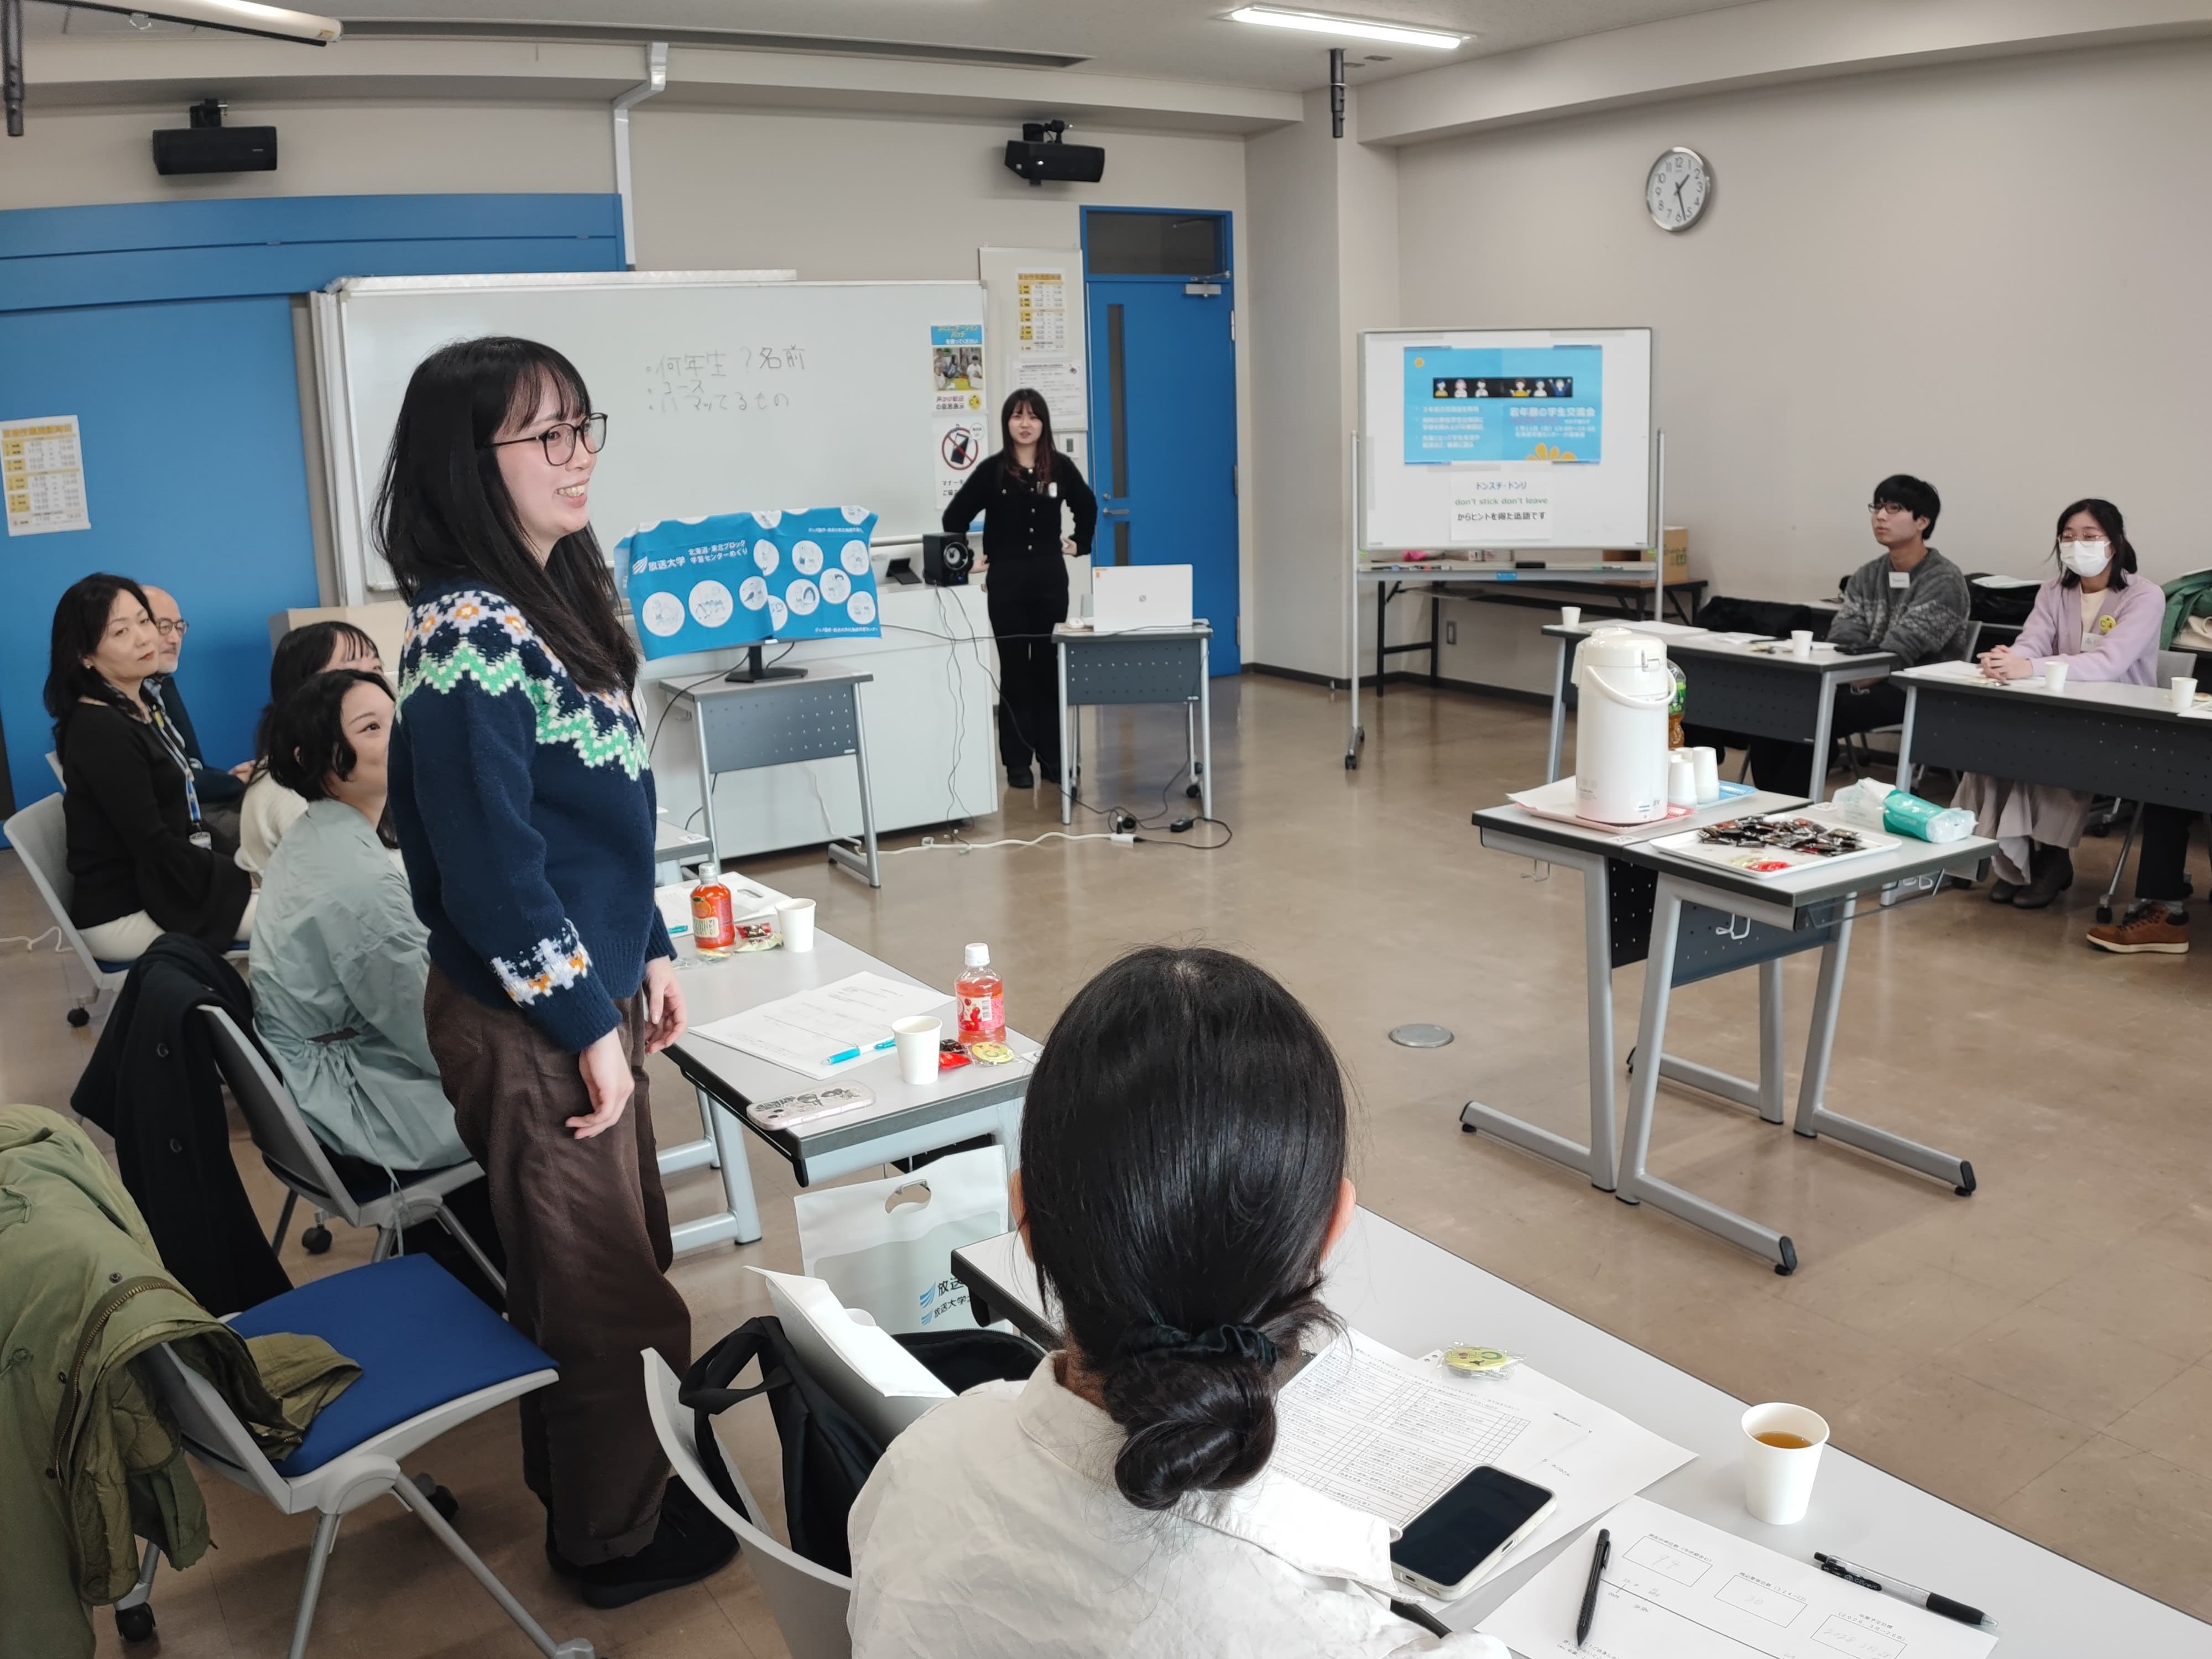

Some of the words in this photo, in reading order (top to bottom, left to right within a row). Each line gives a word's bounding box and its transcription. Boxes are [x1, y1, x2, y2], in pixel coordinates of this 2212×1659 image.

[759, 344, 805, 370] 名前
[663, 378, 704, 394] コース
[648, 556, 686, 571] 放送大学
